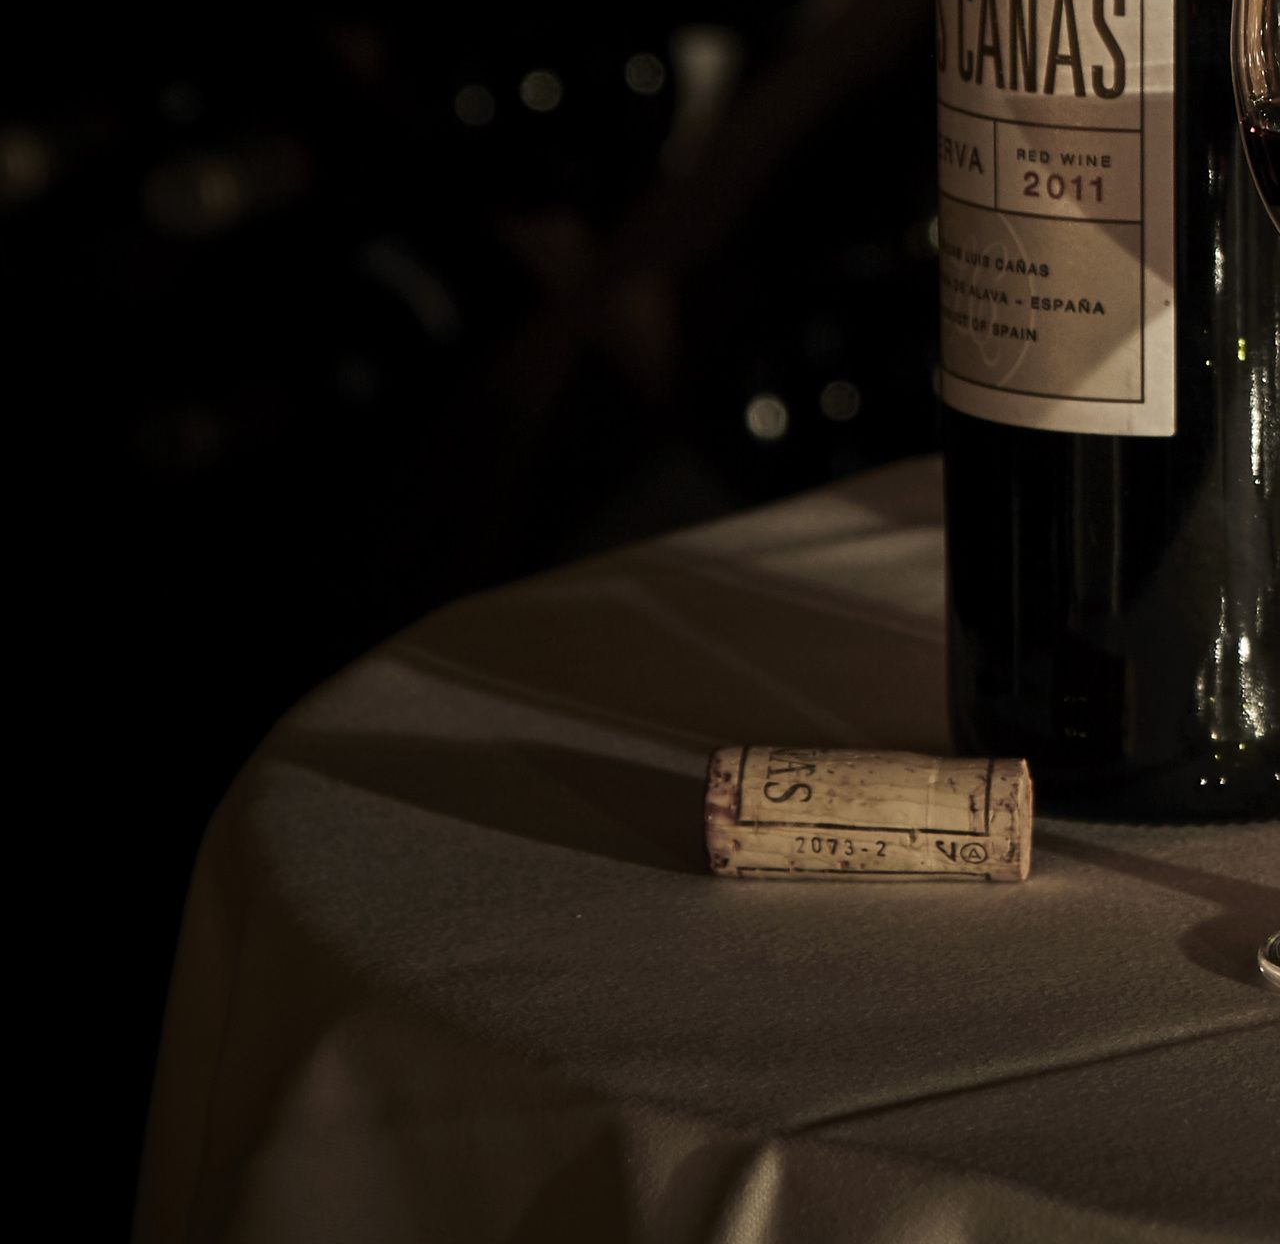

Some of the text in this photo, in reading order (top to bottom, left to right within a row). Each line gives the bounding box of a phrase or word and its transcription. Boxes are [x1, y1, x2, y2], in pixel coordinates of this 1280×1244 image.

[1016, 148, 1113, 168] RED WINE
[1023, 171, 1104, 202] 2011
[995, 258, 1050, 277] CAÑAS
[1030, 297, 1106, 315] ESPAÑA
[991, 322, 1037, 342] SPAIN
[795, 836, 887, 858] 2073-2
